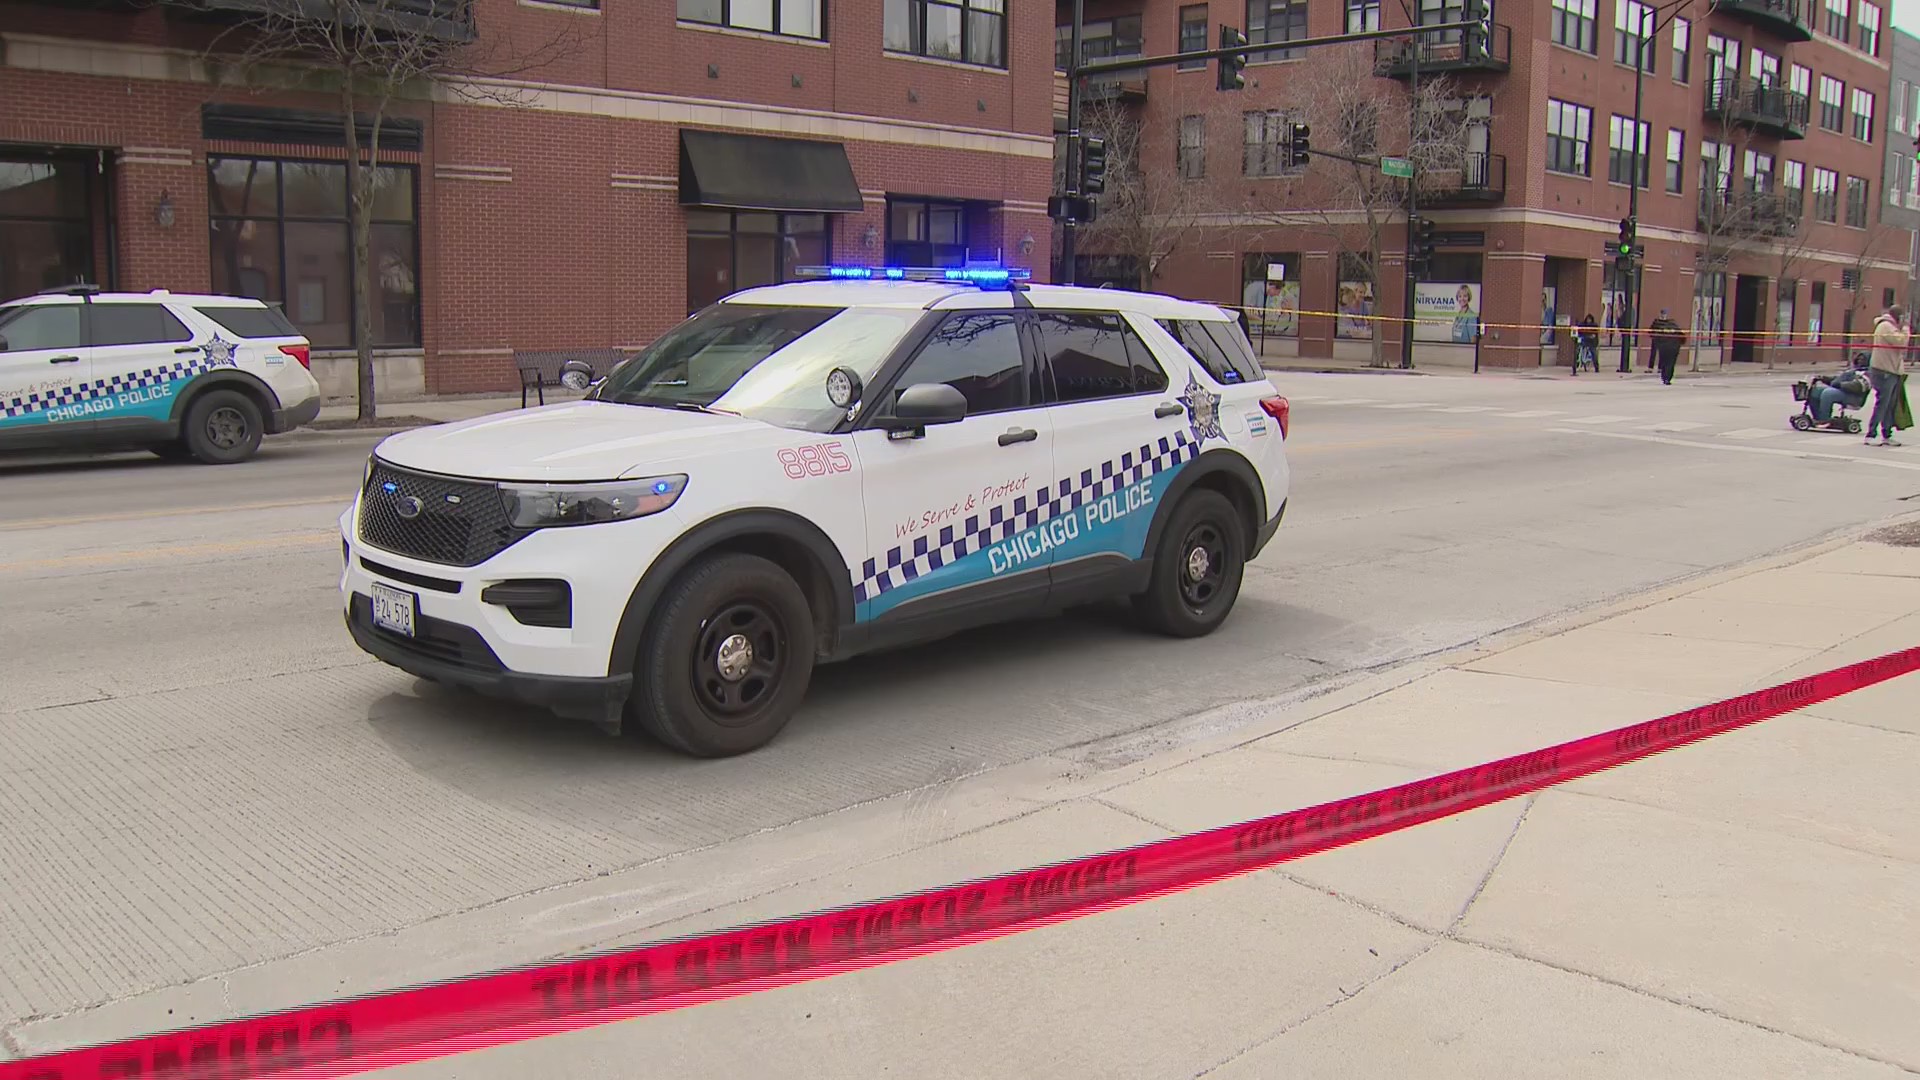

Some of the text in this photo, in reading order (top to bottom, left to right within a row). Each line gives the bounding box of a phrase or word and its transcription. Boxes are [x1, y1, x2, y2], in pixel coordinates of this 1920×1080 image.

[1415, 296, 1455, 305] NIRVANA
[47, 384, 172, 422] CHICAGO POLICE
[1193, 416, 1220, 438] POLICE
[777, 441, 852, 479] 8815
[896, 472, 1029, 538] We Serve & Protect
[988, 479, 1154, 575] CHICAGO POLICE
[381, 598, 410, 626] 24 578
